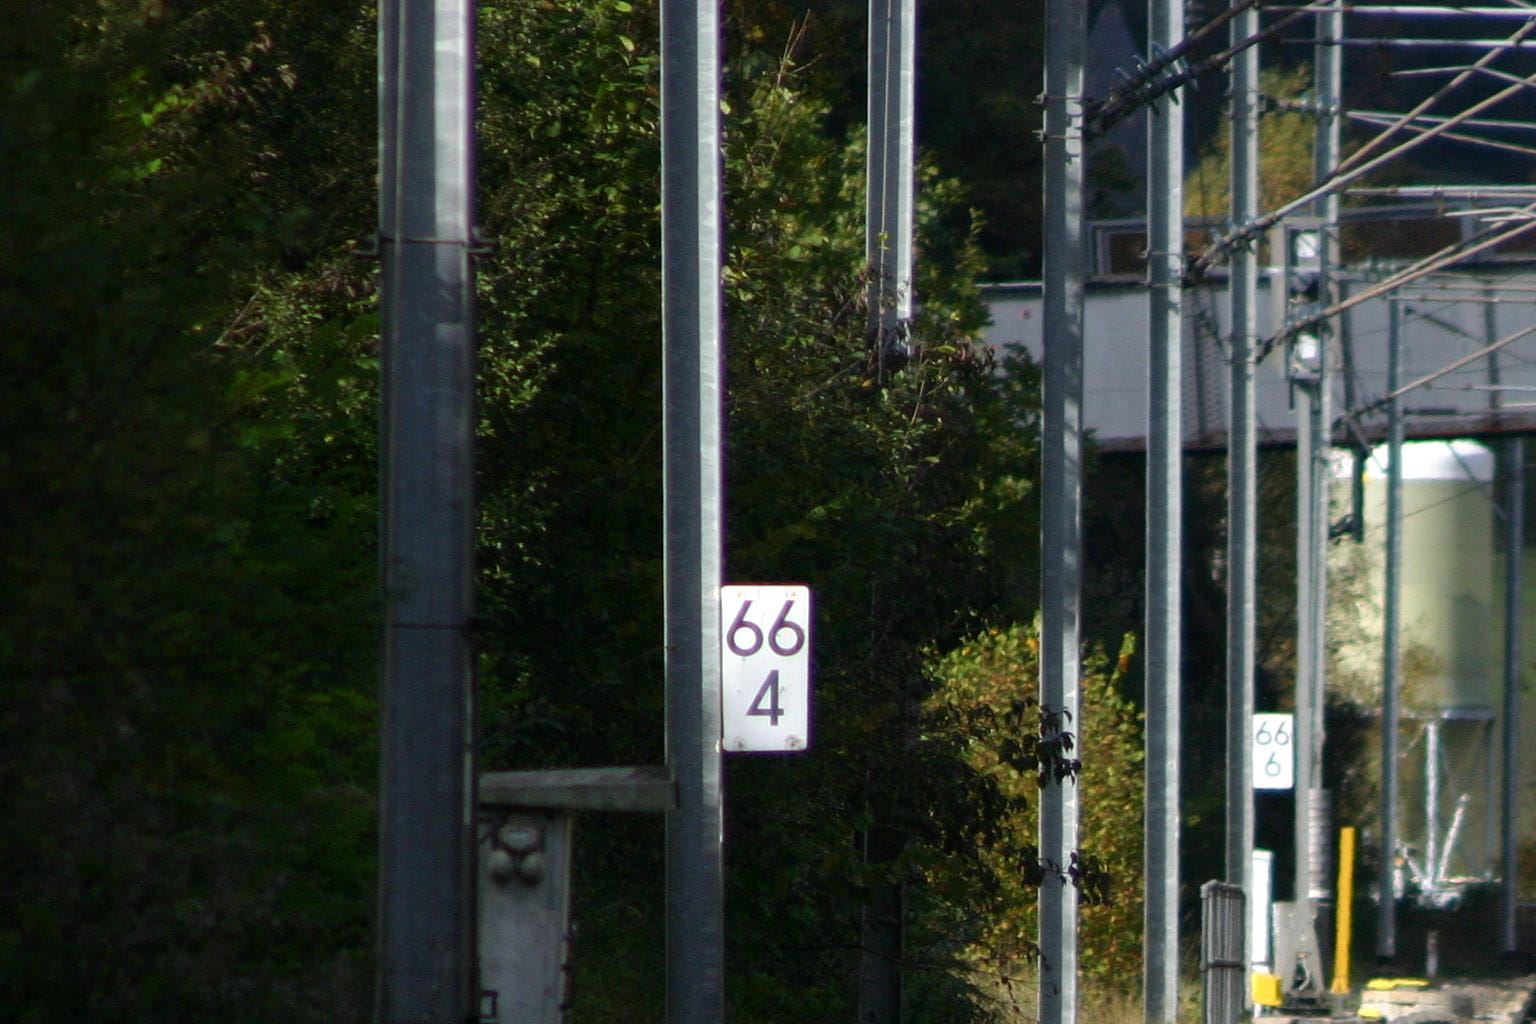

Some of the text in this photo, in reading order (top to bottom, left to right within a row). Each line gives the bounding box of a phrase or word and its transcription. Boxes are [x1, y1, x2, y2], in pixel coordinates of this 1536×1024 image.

[726, 600, 805, 657] 66
[746, 669, 784, 726] 4
[1255, 721, 1289, 746] 66
[1264, 751, 1282, 777] 6
